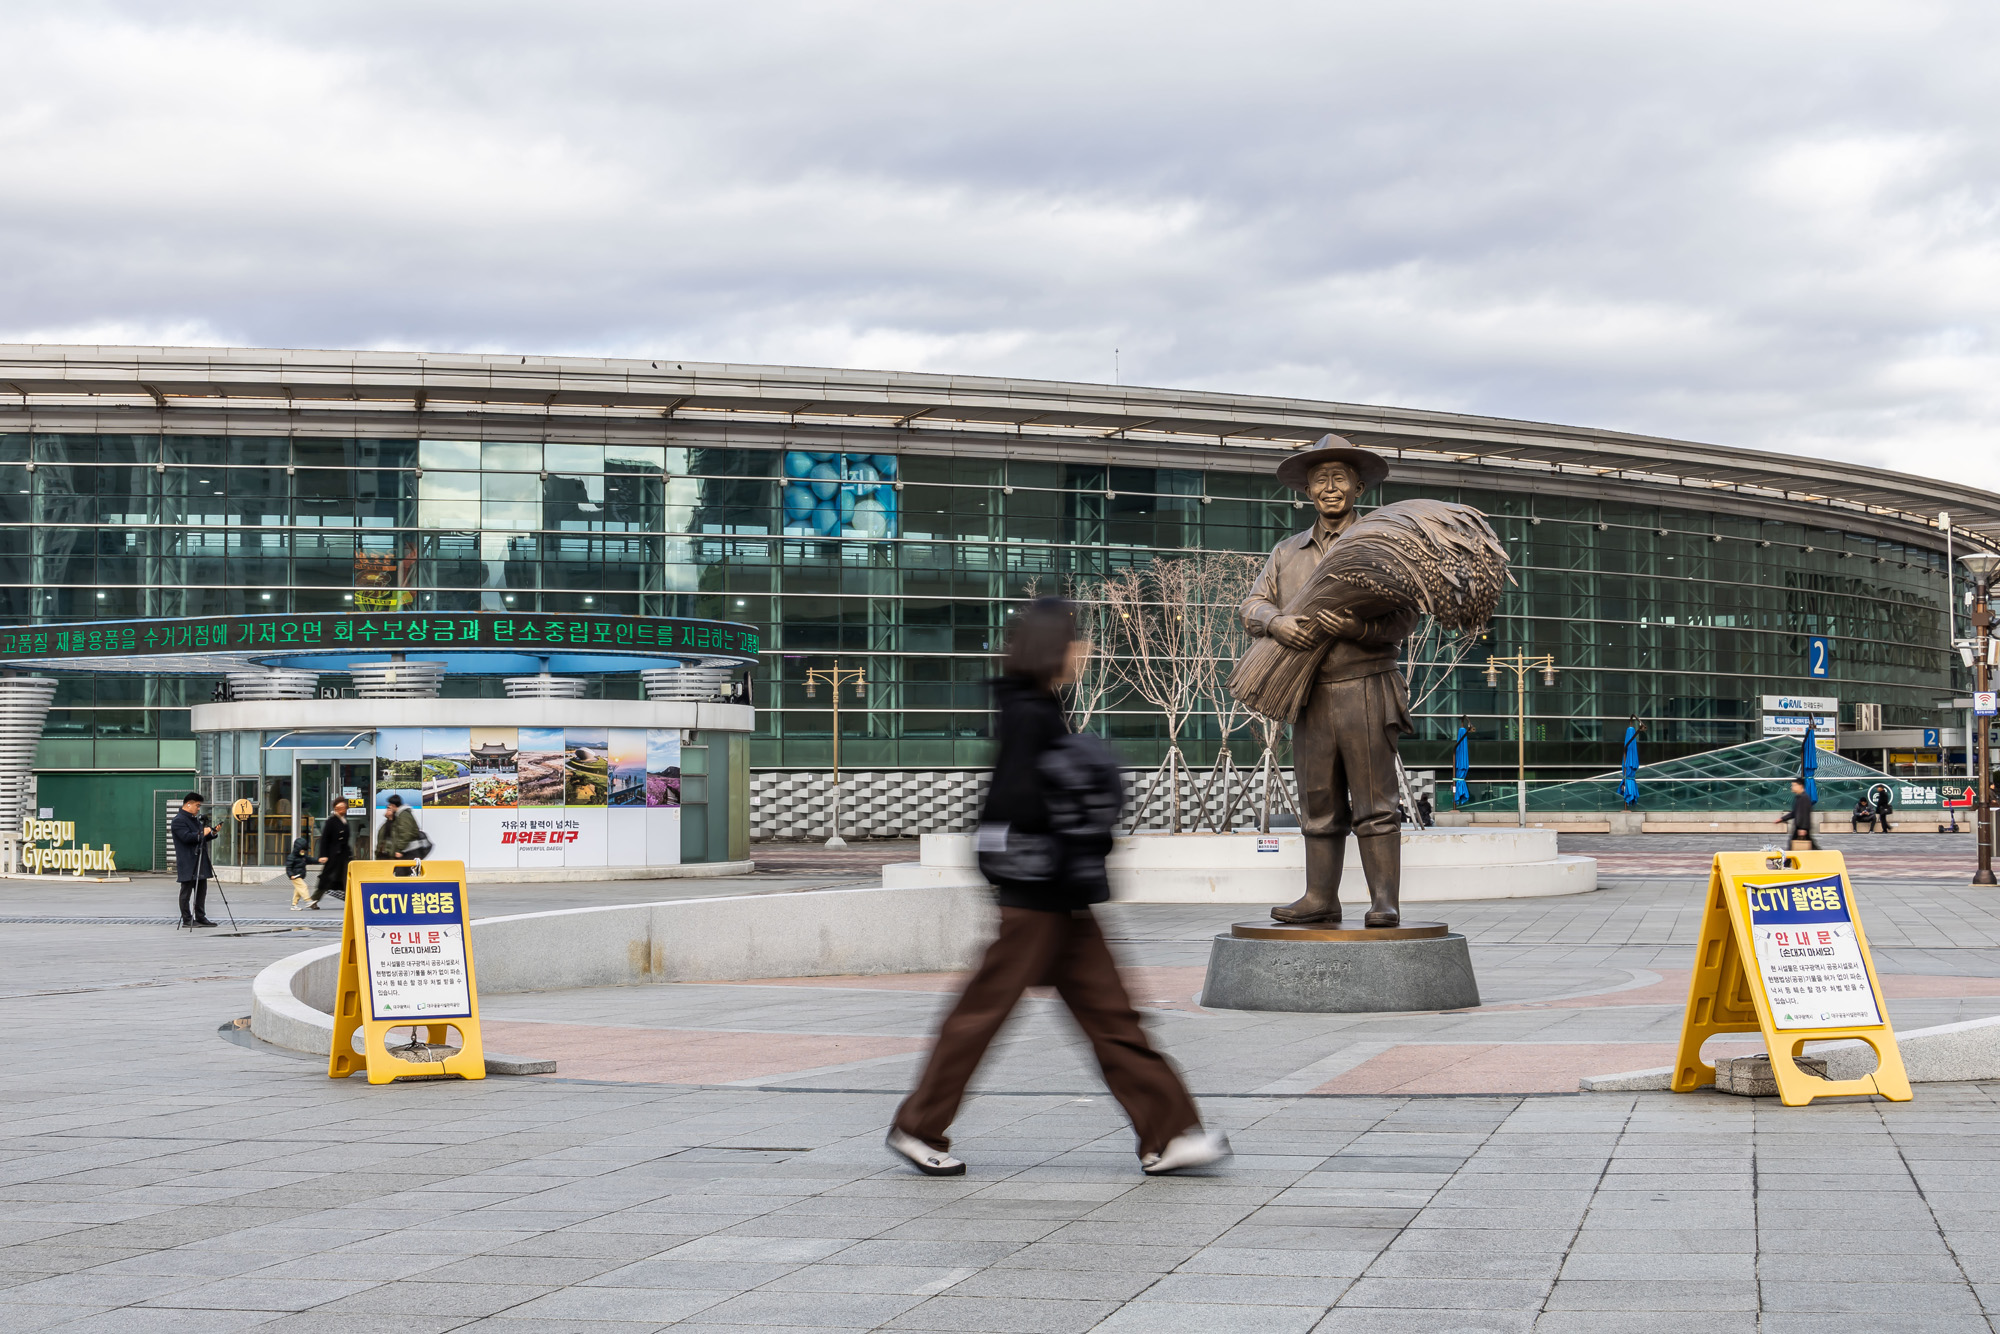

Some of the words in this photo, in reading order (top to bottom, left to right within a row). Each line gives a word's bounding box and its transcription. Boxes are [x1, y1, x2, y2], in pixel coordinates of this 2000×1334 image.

[1, 633, 48, 654] 고품질
[55, 630, 136, 652] 재활용품을
[143, 623, 228, 648] 수거거점에
[236, 621, 322, 644] 가져오면
[332, 619, 481, 643] 회수보상금과
[493, 619, 673, 647] 탄소중립포인트를
[681, 626, 734, 650] 지급하는
[1814, 640, 1825, 675] 2
[1778, 697, 1802, 709] KORAIL
[1927, 730, 1937, 745] 2
[1901, 786, 1937, 800] 흡연실
[1942, 786, 1962, 796] 55m
[501, 820, 527, 829] 자유와
[530, 820, 553, 829] 활력이
[556, 820, 580, 829] 넘치는
[22, 816, 75, 847] Daegu
[501, 831, 547, 844] 파워풀
[549, 831, 579, 843] 대구
[22, 842, 116, 876] Gyeongbuk
[370, 893, 408, 914] CCTV
[411, 892, 455, 914] 촬영중
[1791, 886, 1841, 912] 촬영중
[391, 946, 415, 955] (손대지
[416, 945, 441, 954] 마세요)
[1779, 948, 1806, 958] (손대지
[1807, 946, 1835, 956] 마세요)
[431, 959, 460, 967] 공공시설로서
[1799, 963, 1825, 971] 대구광역시
[1826, 962, 1859, 970] 공공시설로서
